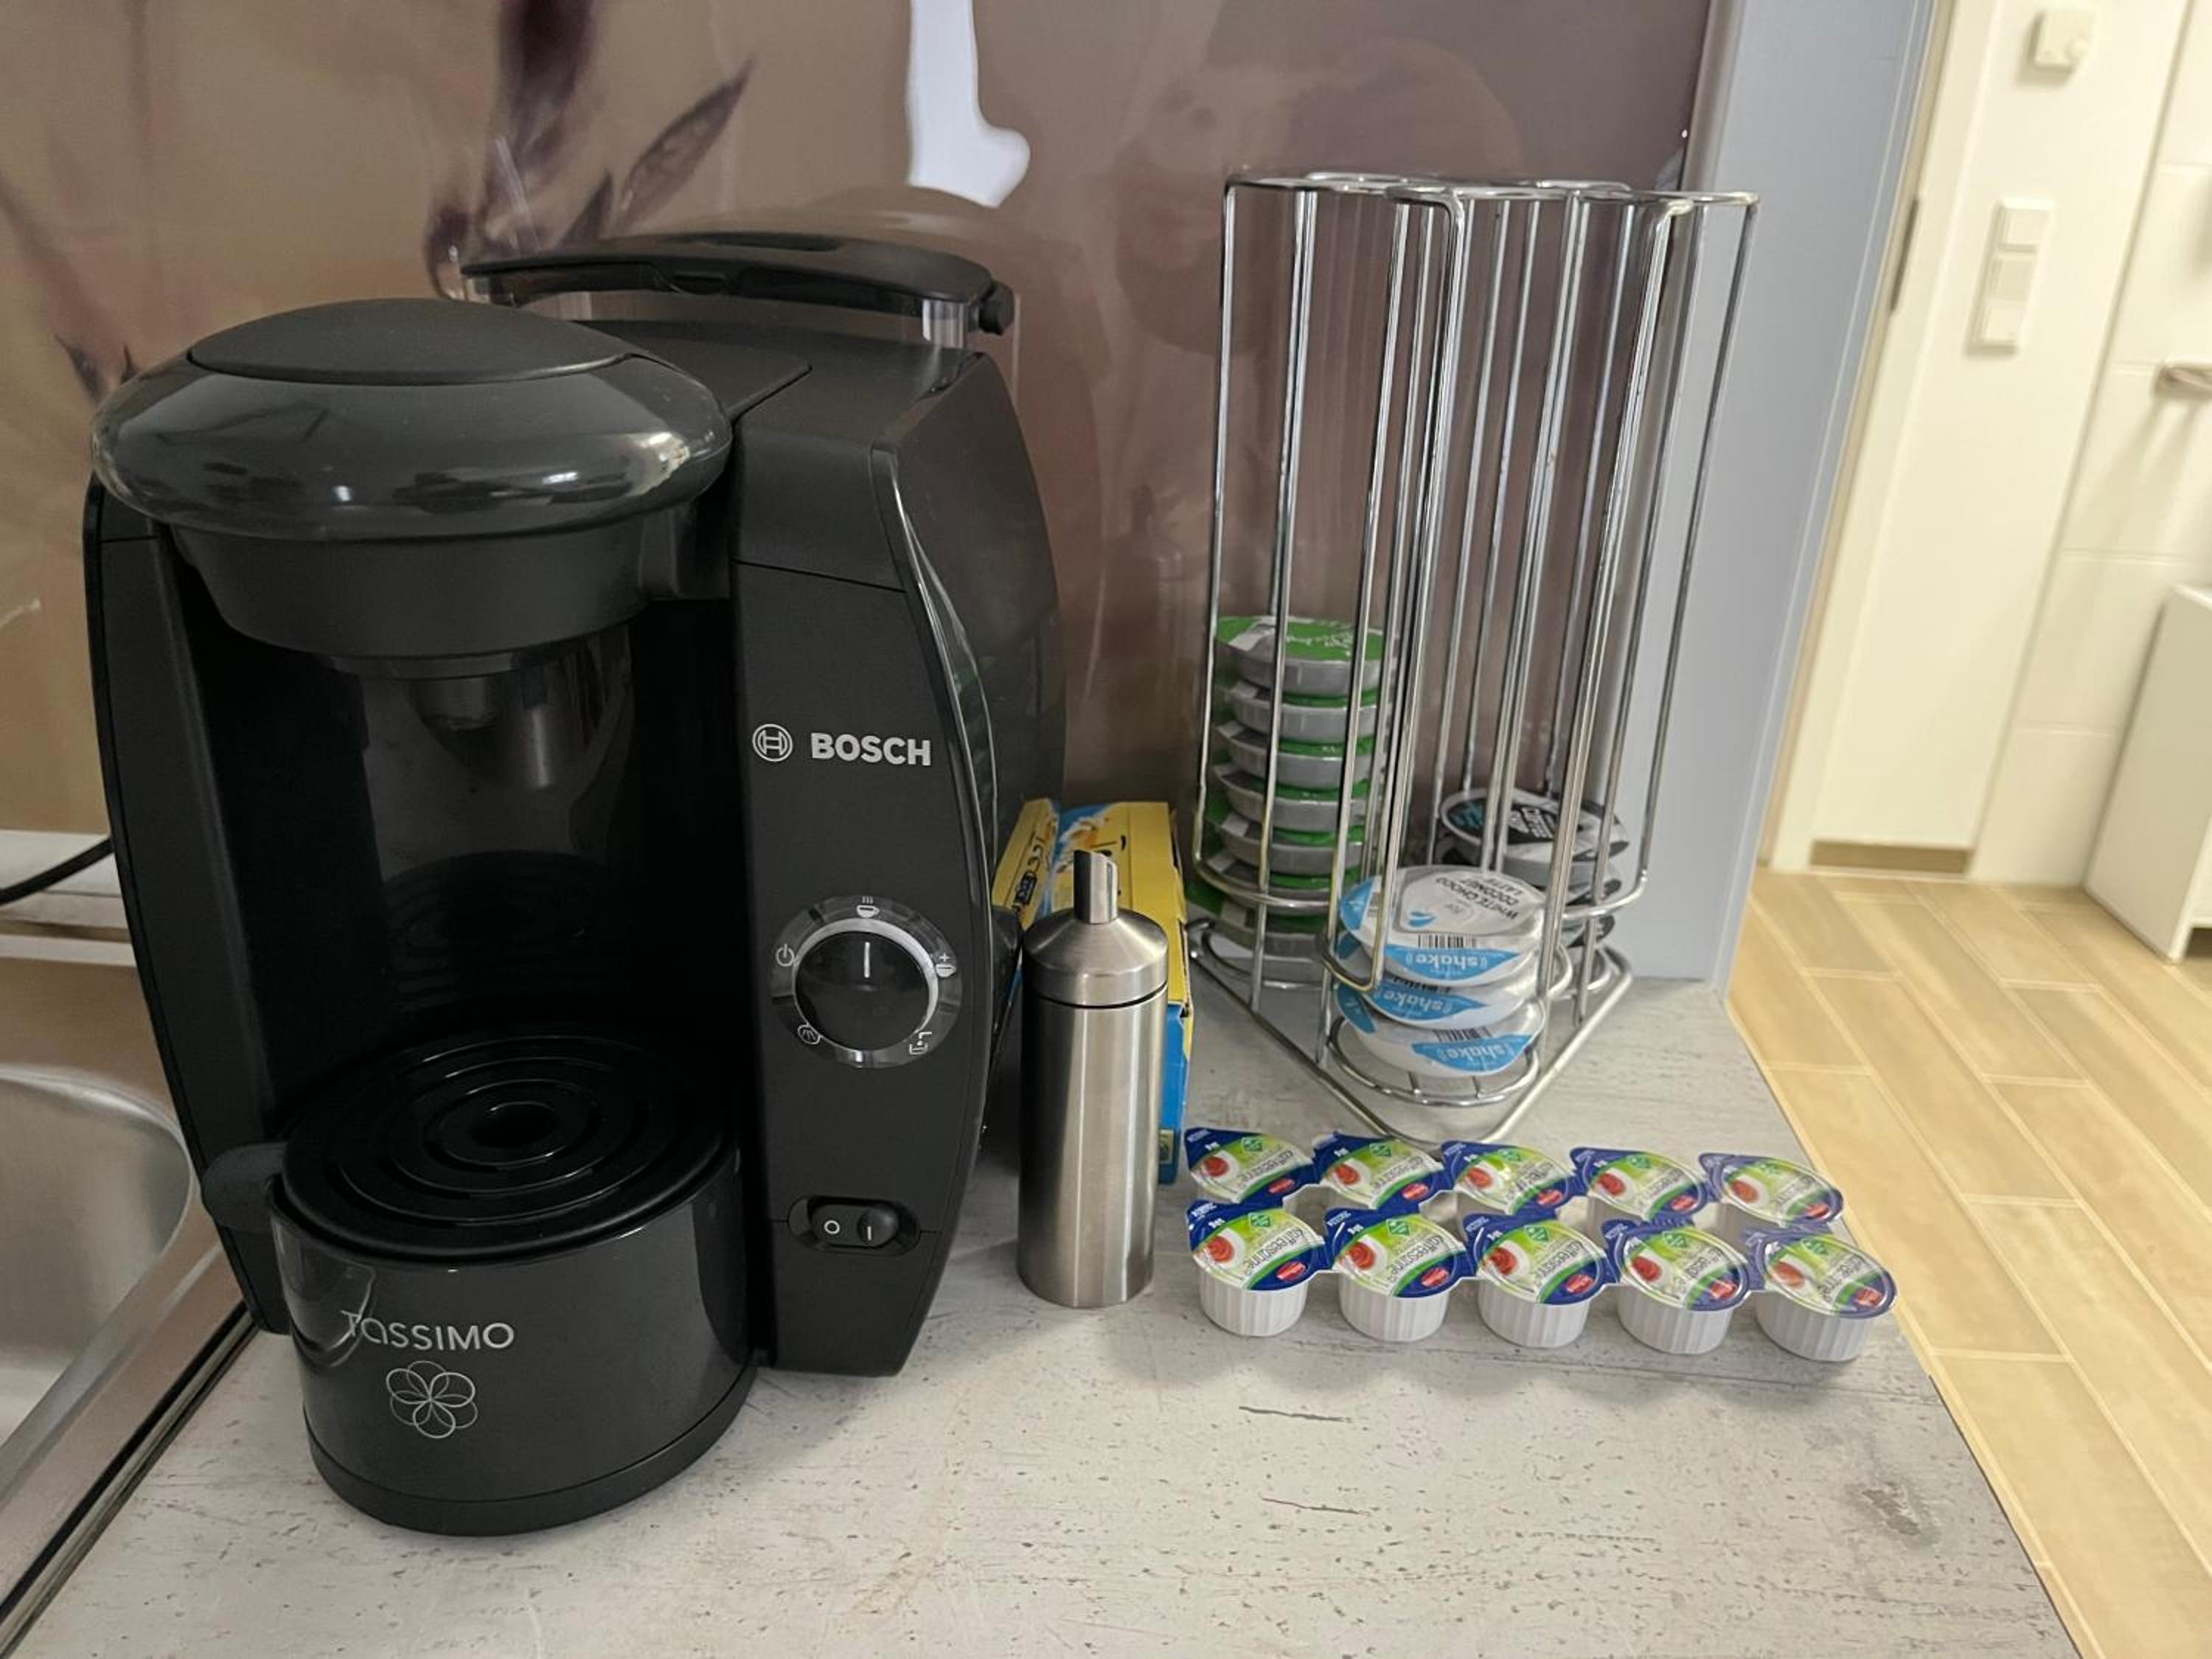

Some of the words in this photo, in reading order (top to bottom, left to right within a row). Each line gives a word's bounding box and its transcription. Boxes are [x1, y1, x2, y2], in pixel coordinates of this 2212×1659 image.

[810, 732, 931, 766] BOSCH
[1436, 877, 1479, 900] CHOCO
[1415, 953, 1479, 970] shake
[1382, 991, 1444, 1012] shake
[1446, 1044, 1506, 1062] shake
[341, 1310, 515, 1351] TASSIMO
